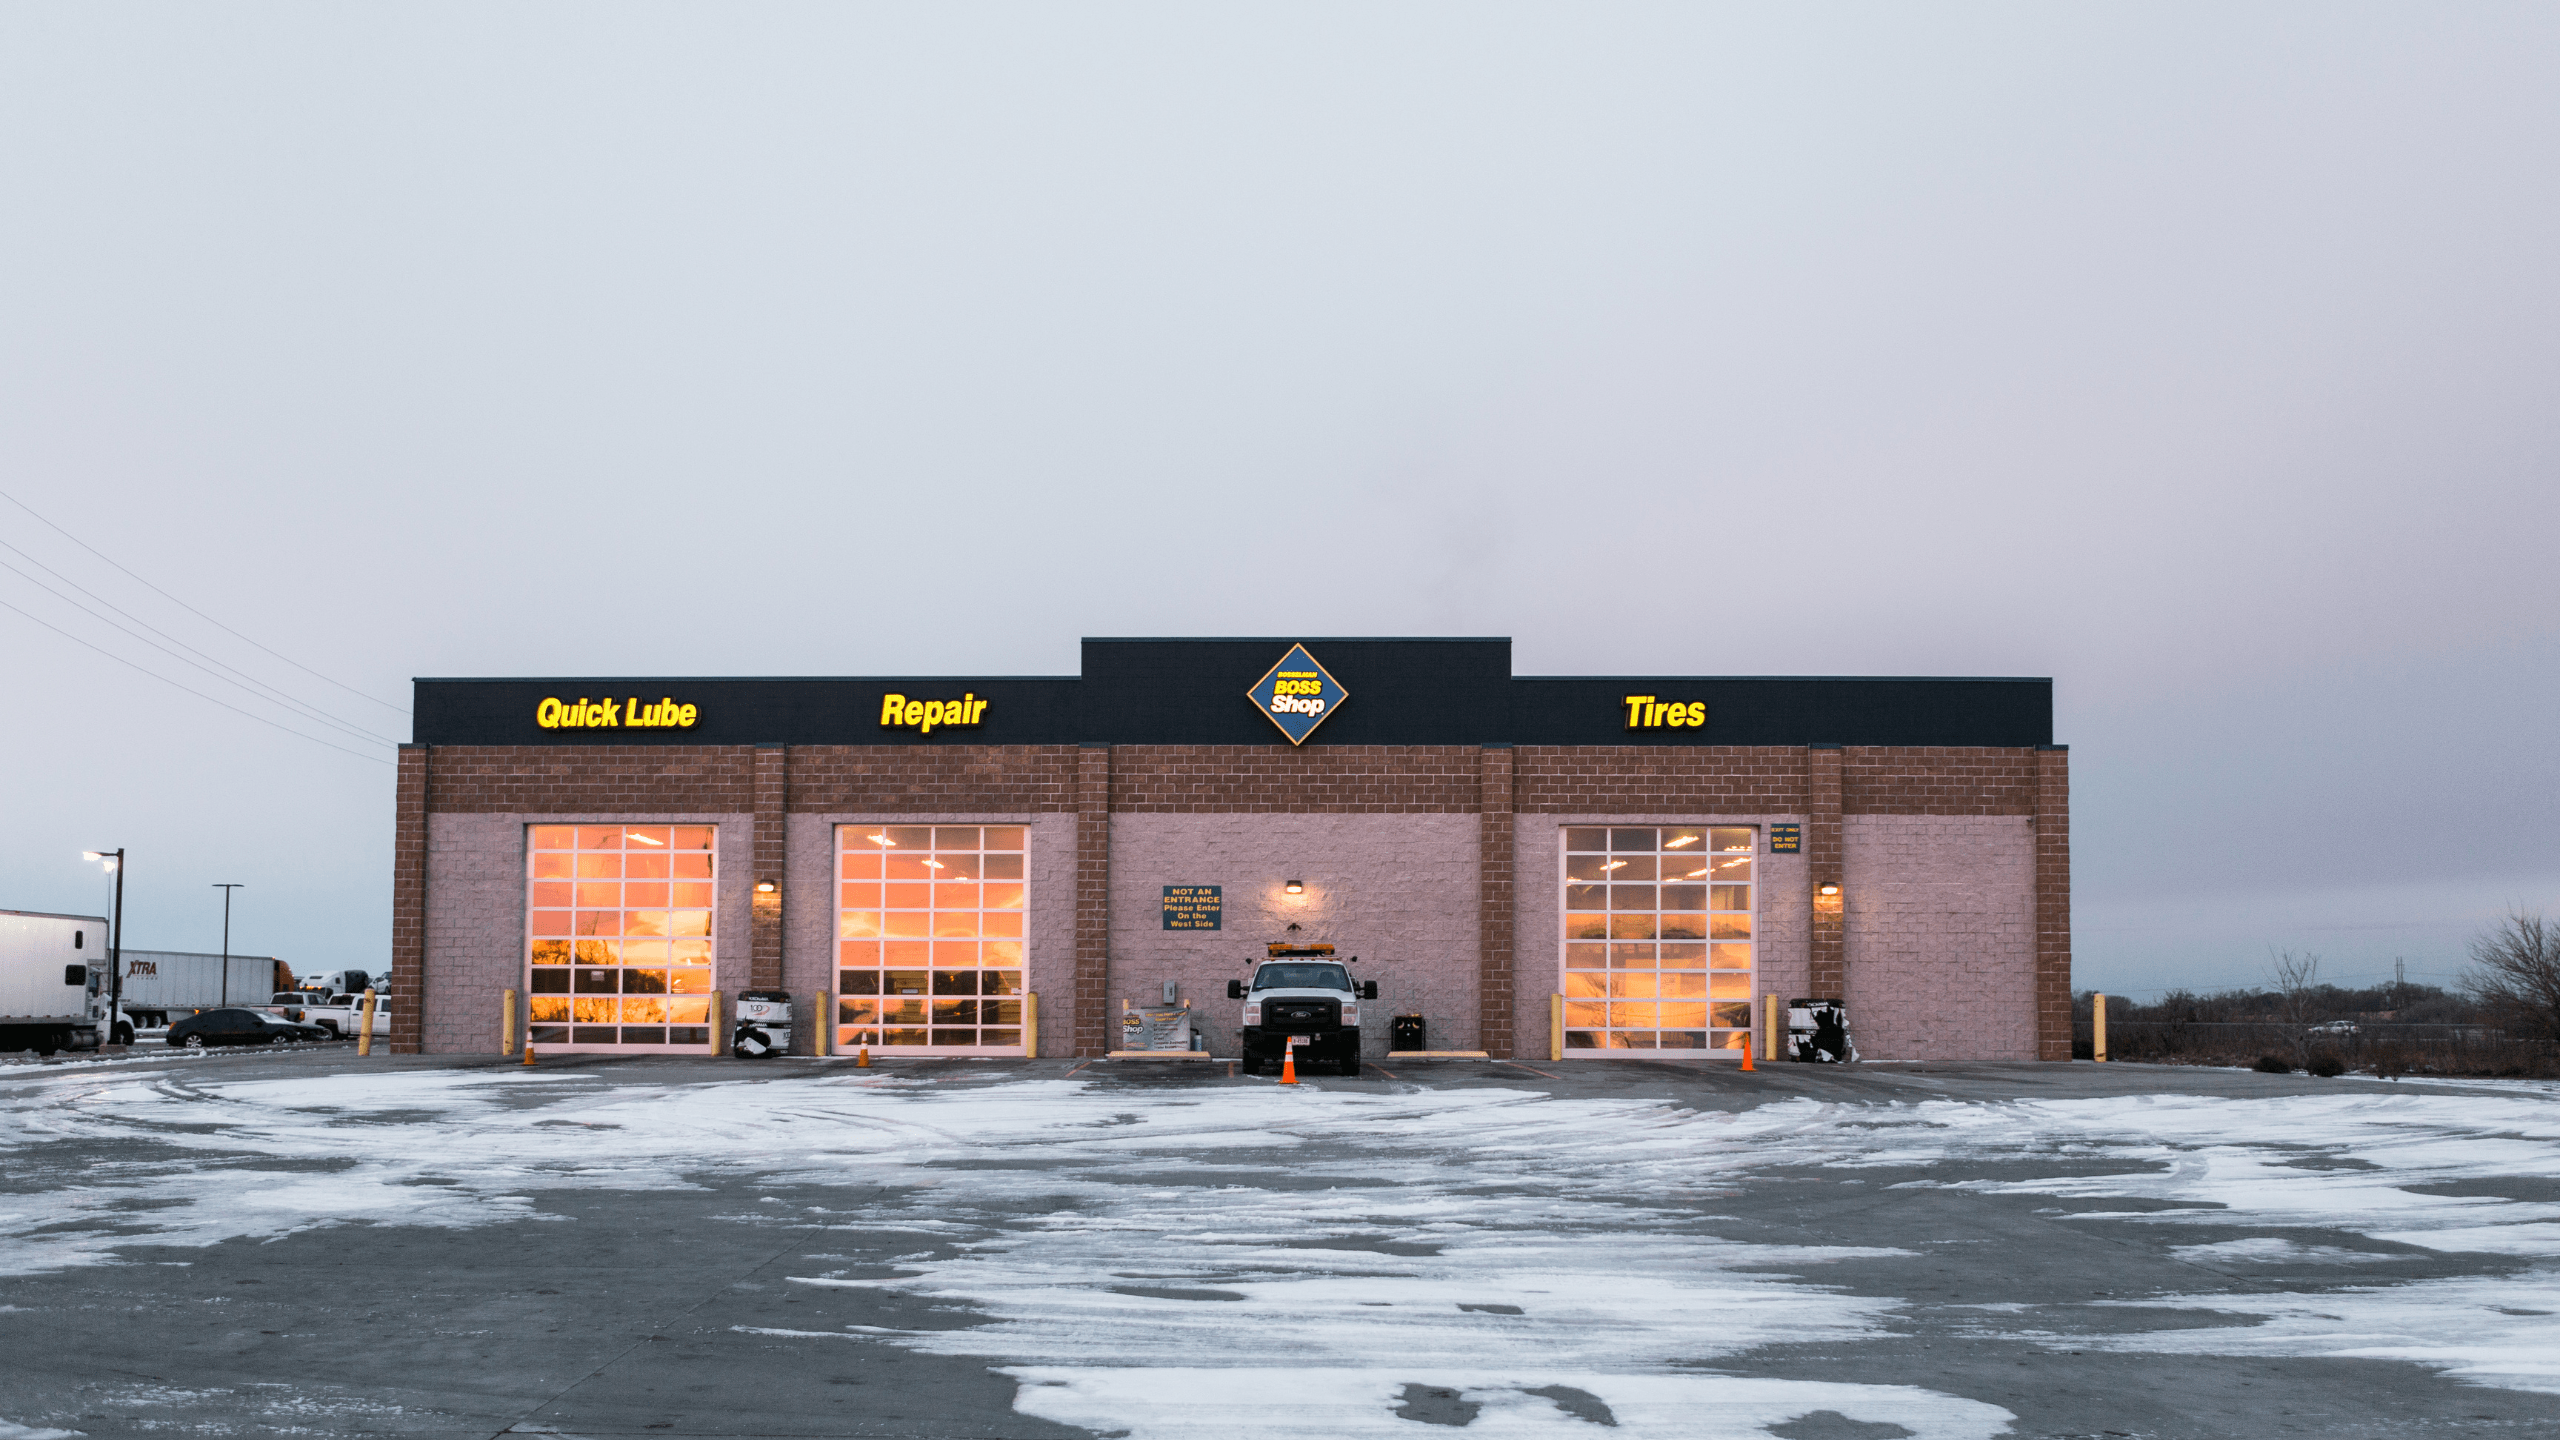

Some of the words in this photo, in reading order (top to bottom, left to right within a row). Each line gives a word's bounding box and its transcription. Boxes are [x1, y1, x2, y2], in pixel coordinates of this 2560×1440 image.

[1274, 680, 1322, 695] BOSS
[537, 697, 621, 729] Quick
[625, 697, 697, 727] Lube
[880, 693, 987, 733] Repair
[1270, 694, 1325, 717] Shop
[1626, 695, 1706, 727] Tires
[126, 960, 157, 978] XTRA
[1123, 1025, 1144, 1034] Shop
